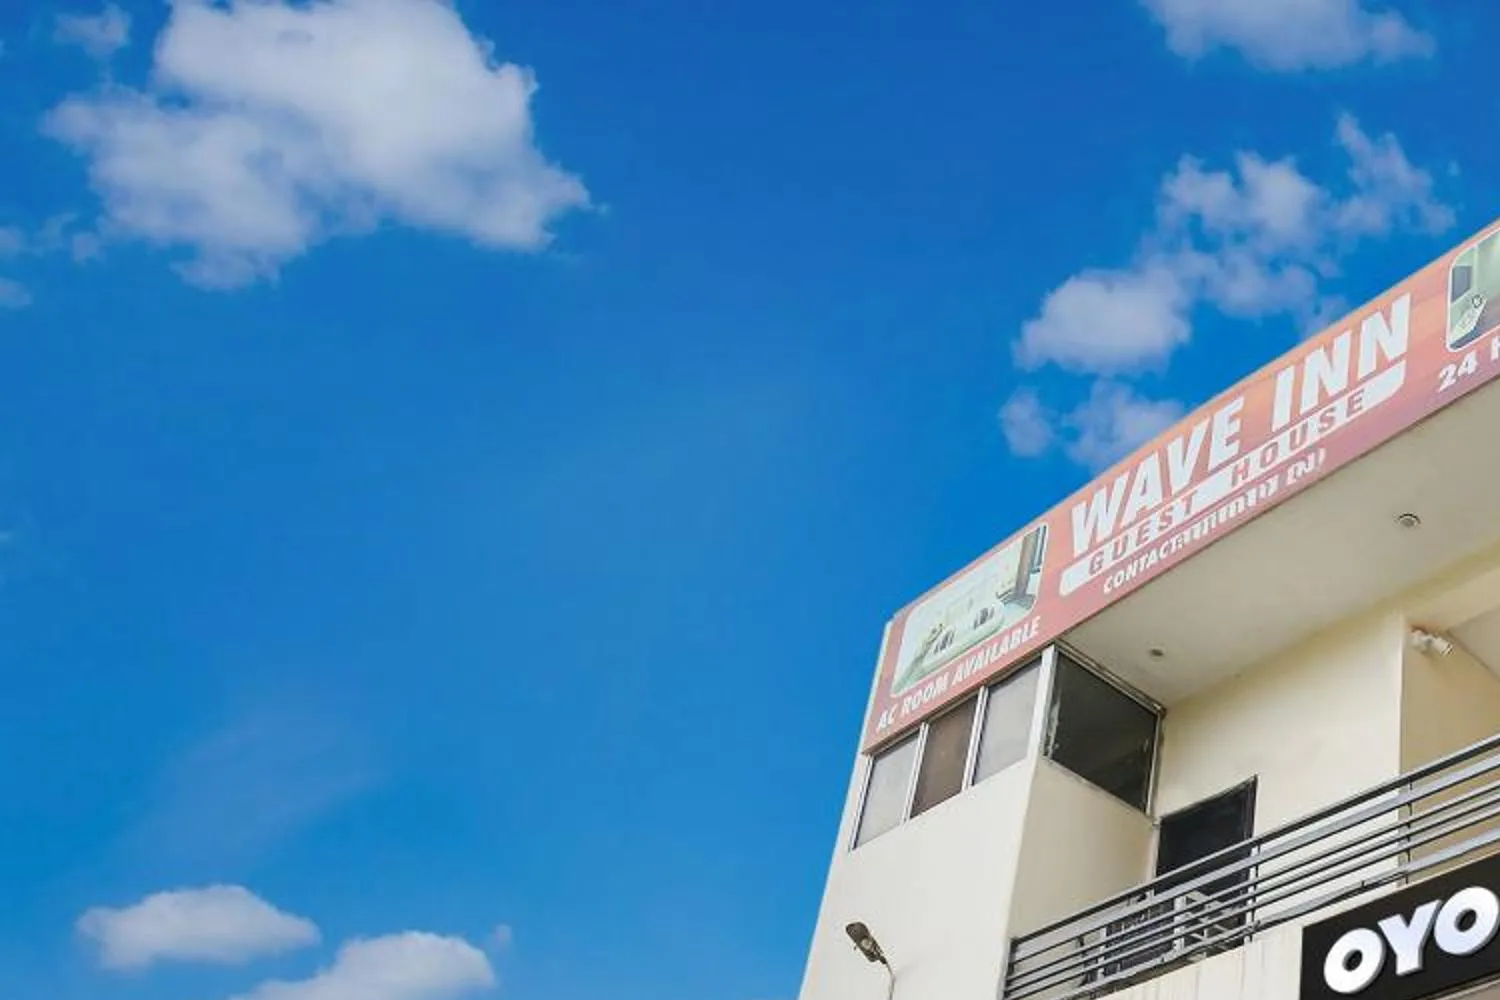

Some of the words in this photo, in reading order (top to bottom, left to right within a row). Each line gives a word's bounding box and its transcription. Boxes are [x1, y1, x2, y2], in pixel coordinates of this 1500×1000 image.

[1070, 396, 1245, 557] WAVE
[1272, 292, 1411, 432] INN
[1437, 351, 1479, 392] 24
[1088, 490, 1203, 576] GUEST
[1231, 388, 1365, 486] HOUSE
[875, 703, 899, 734] AC
[901, 681, 950, 715] ROOM
[951, 615, 1041, 685] AVAILABLE
